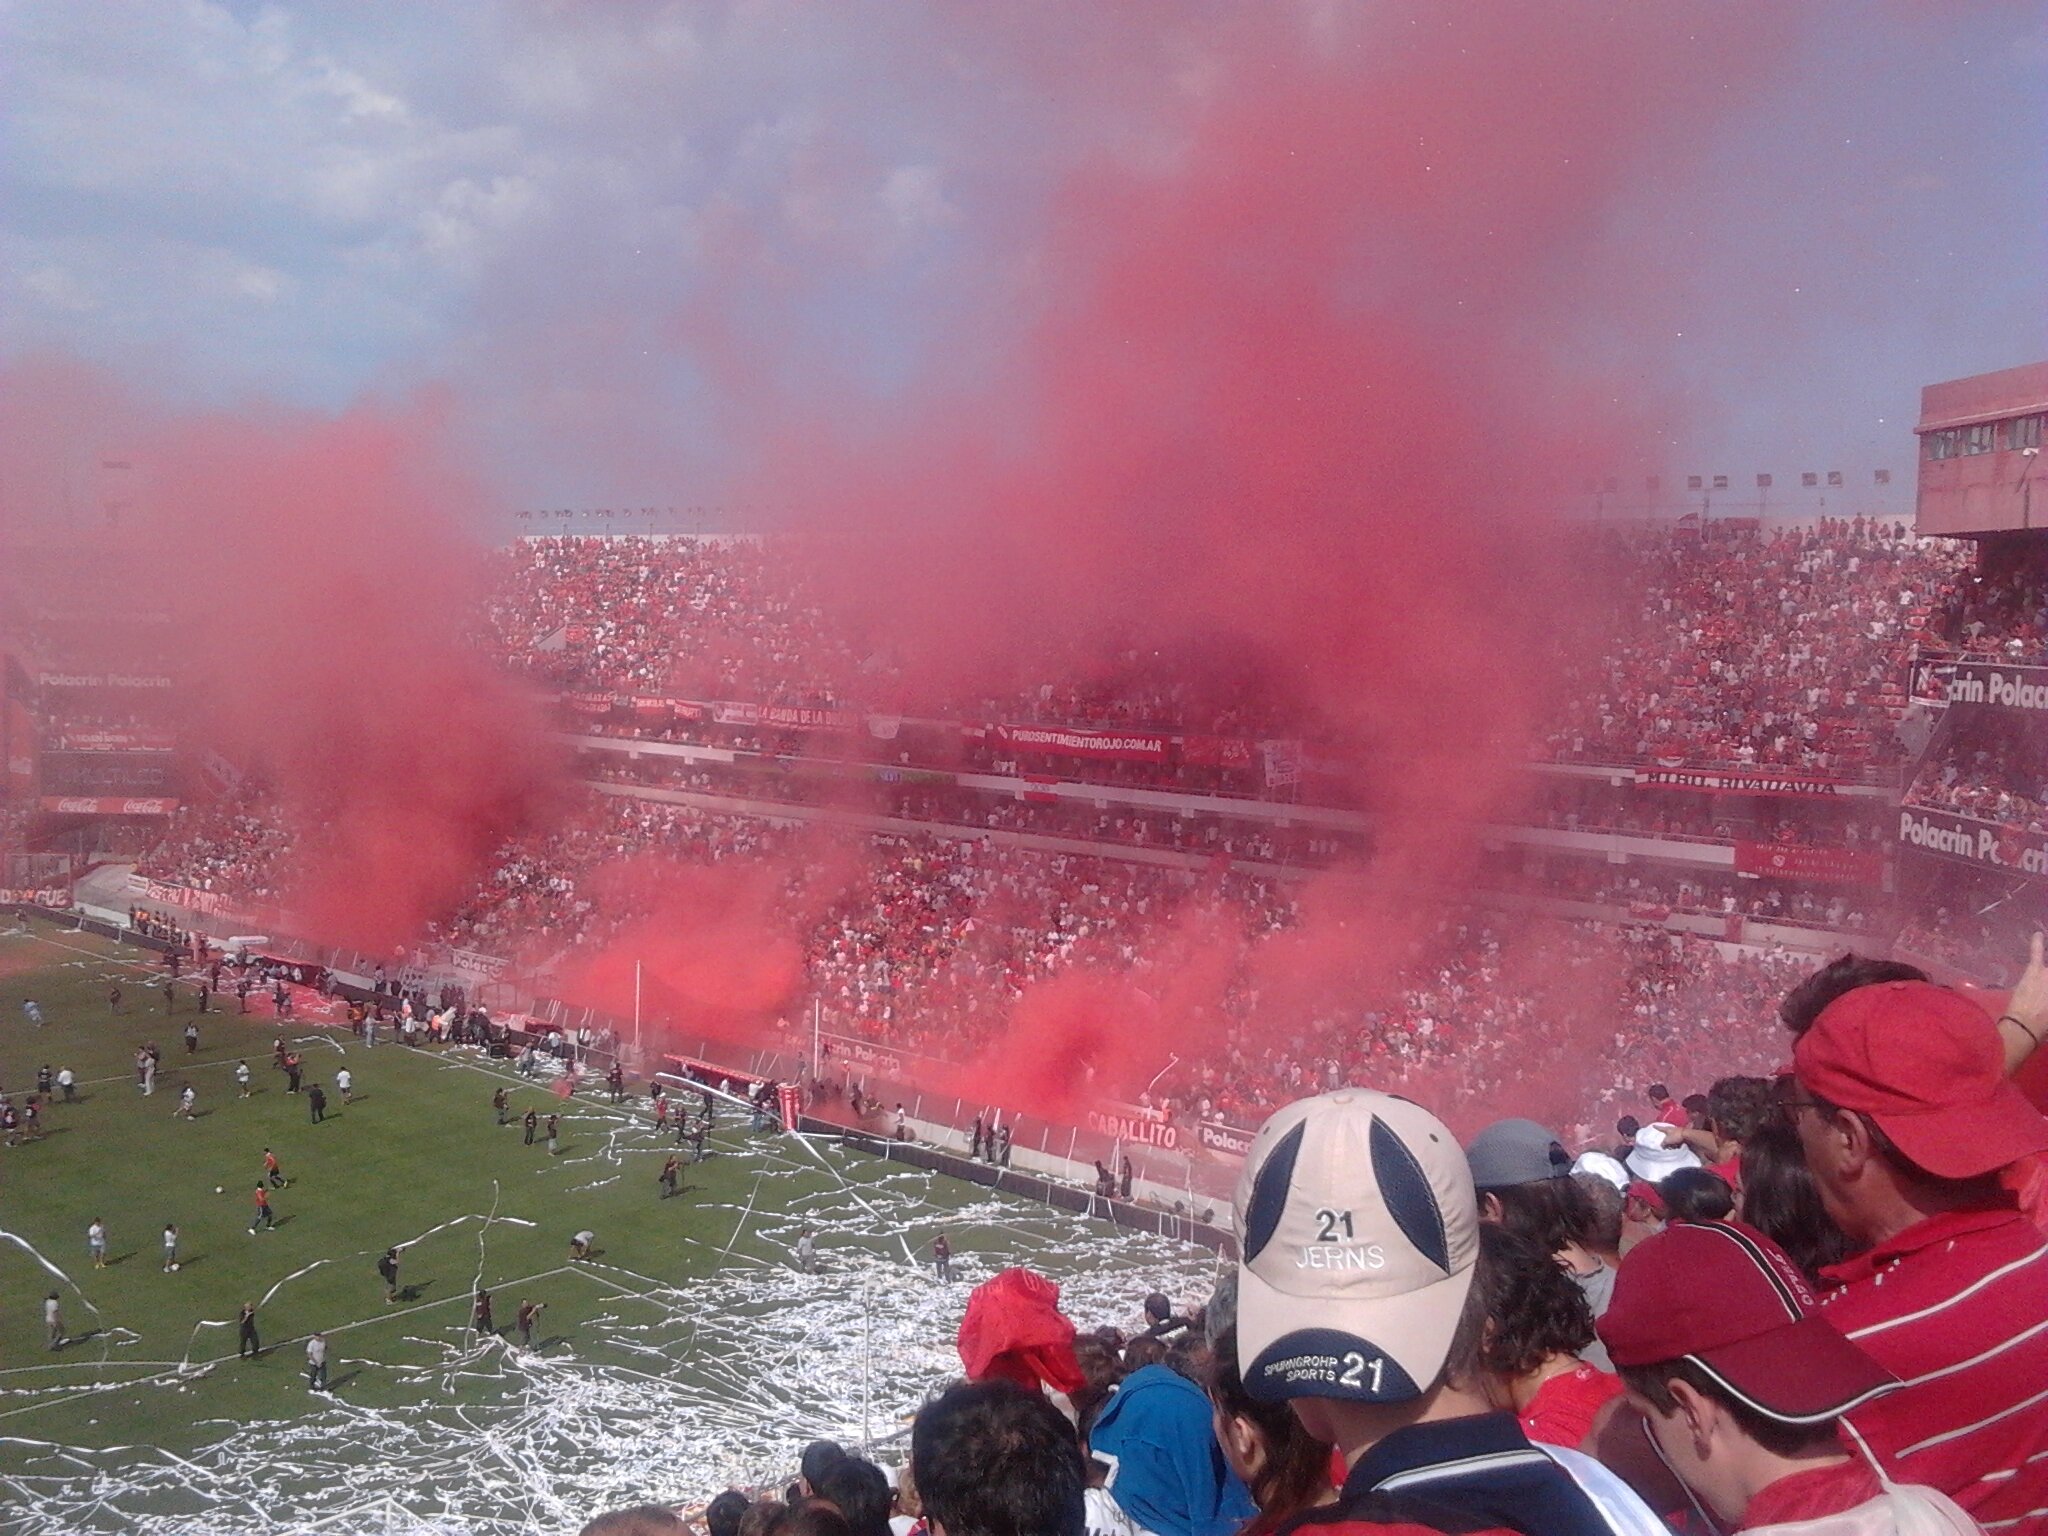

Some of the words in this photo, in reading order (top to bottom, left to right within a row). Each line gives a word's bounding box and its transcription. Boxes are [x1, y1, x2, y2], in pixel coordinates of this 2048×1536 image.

[40, 672, 102, 686] Polacrin
[1948, 671, 1984, 703] crin
[1989, 672, 2048, 710] Polac
[1900, 811, 1973, 858] Polacrin
[1978, 828, 2048, 875] Pocri
[453, 953, 489, 973] Polac
[1088, 1110, 1177, 1148] CABALLITO
[1203, 1127, 1251, 1151] Polacr
[1316, 1208, 1354, 1242] 21
[1295, 1245, 1385, 1270] JERNS
[1286, 1368, 1335, 1382] SPORTS
[1340, 1351, 1383, 1393] 21
